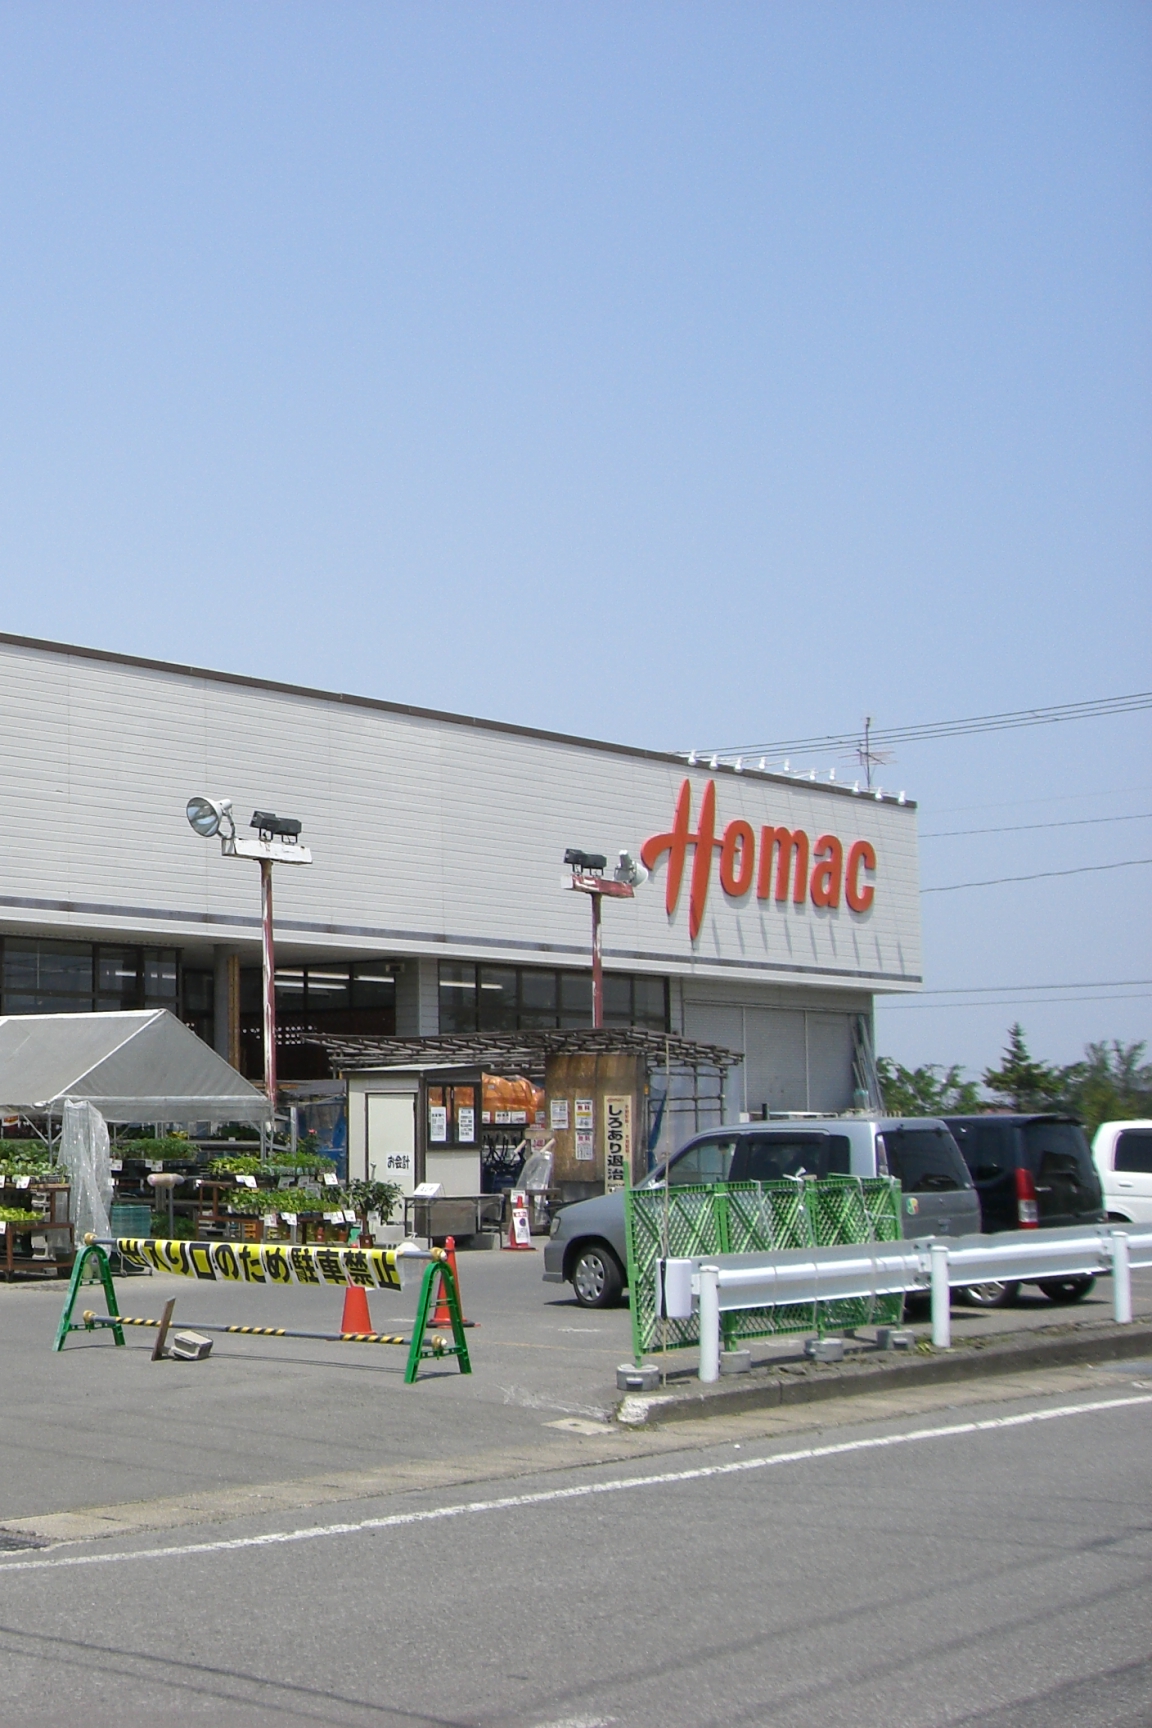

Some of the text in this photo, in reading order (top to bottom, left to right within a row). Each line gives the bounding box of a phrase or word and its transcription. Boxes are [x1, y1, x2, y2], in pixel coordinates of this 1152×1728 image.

[641, 778, 877, 941] Homac
[387, 1155, 410, 1170] お会計
[607, 1104, 624, 1181] しろあり退治
[117, 1239, 402, 1292] 出入り口のため駐車禁止
